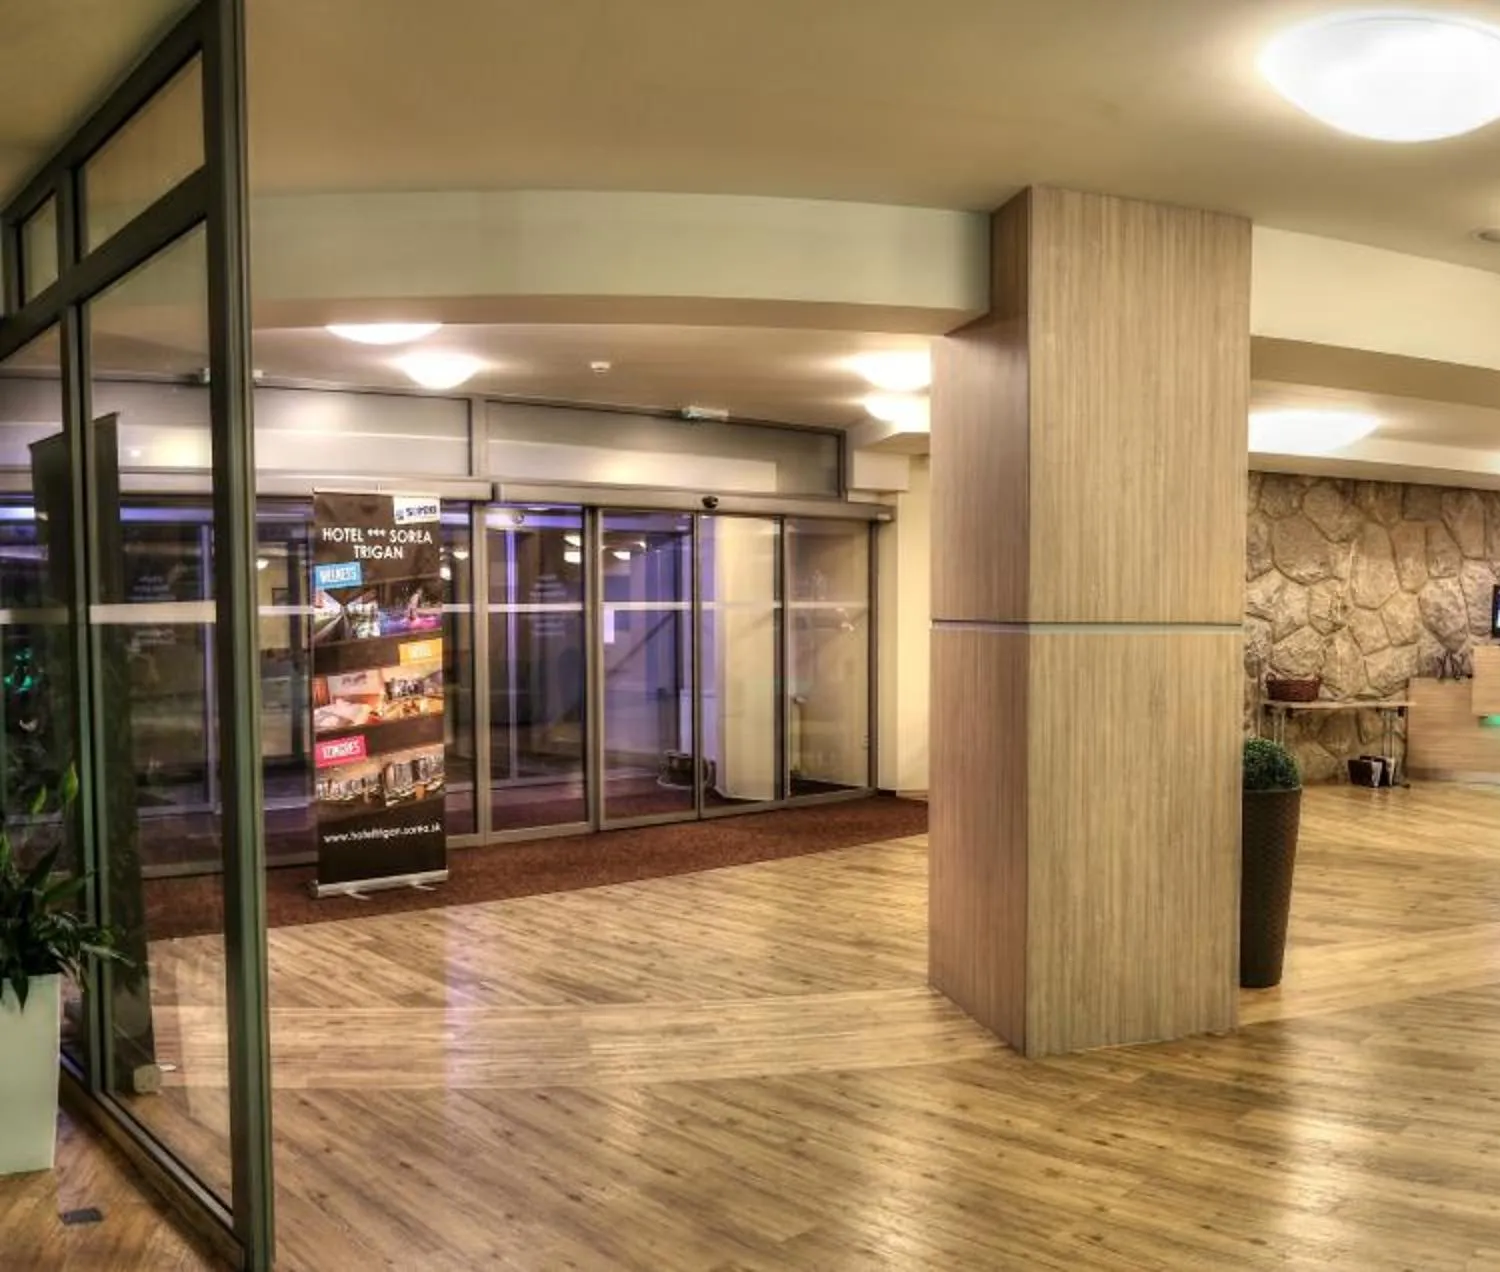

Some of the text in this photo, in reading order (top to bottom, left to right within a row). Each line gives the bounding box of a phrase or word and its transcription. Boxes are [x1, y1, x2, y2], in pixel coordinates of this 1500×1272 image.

[322, 527, 364, 543] HOTEL
[389, 529, 433, 545] SOREA
[353, 545, 404, 560] TRIGAN
